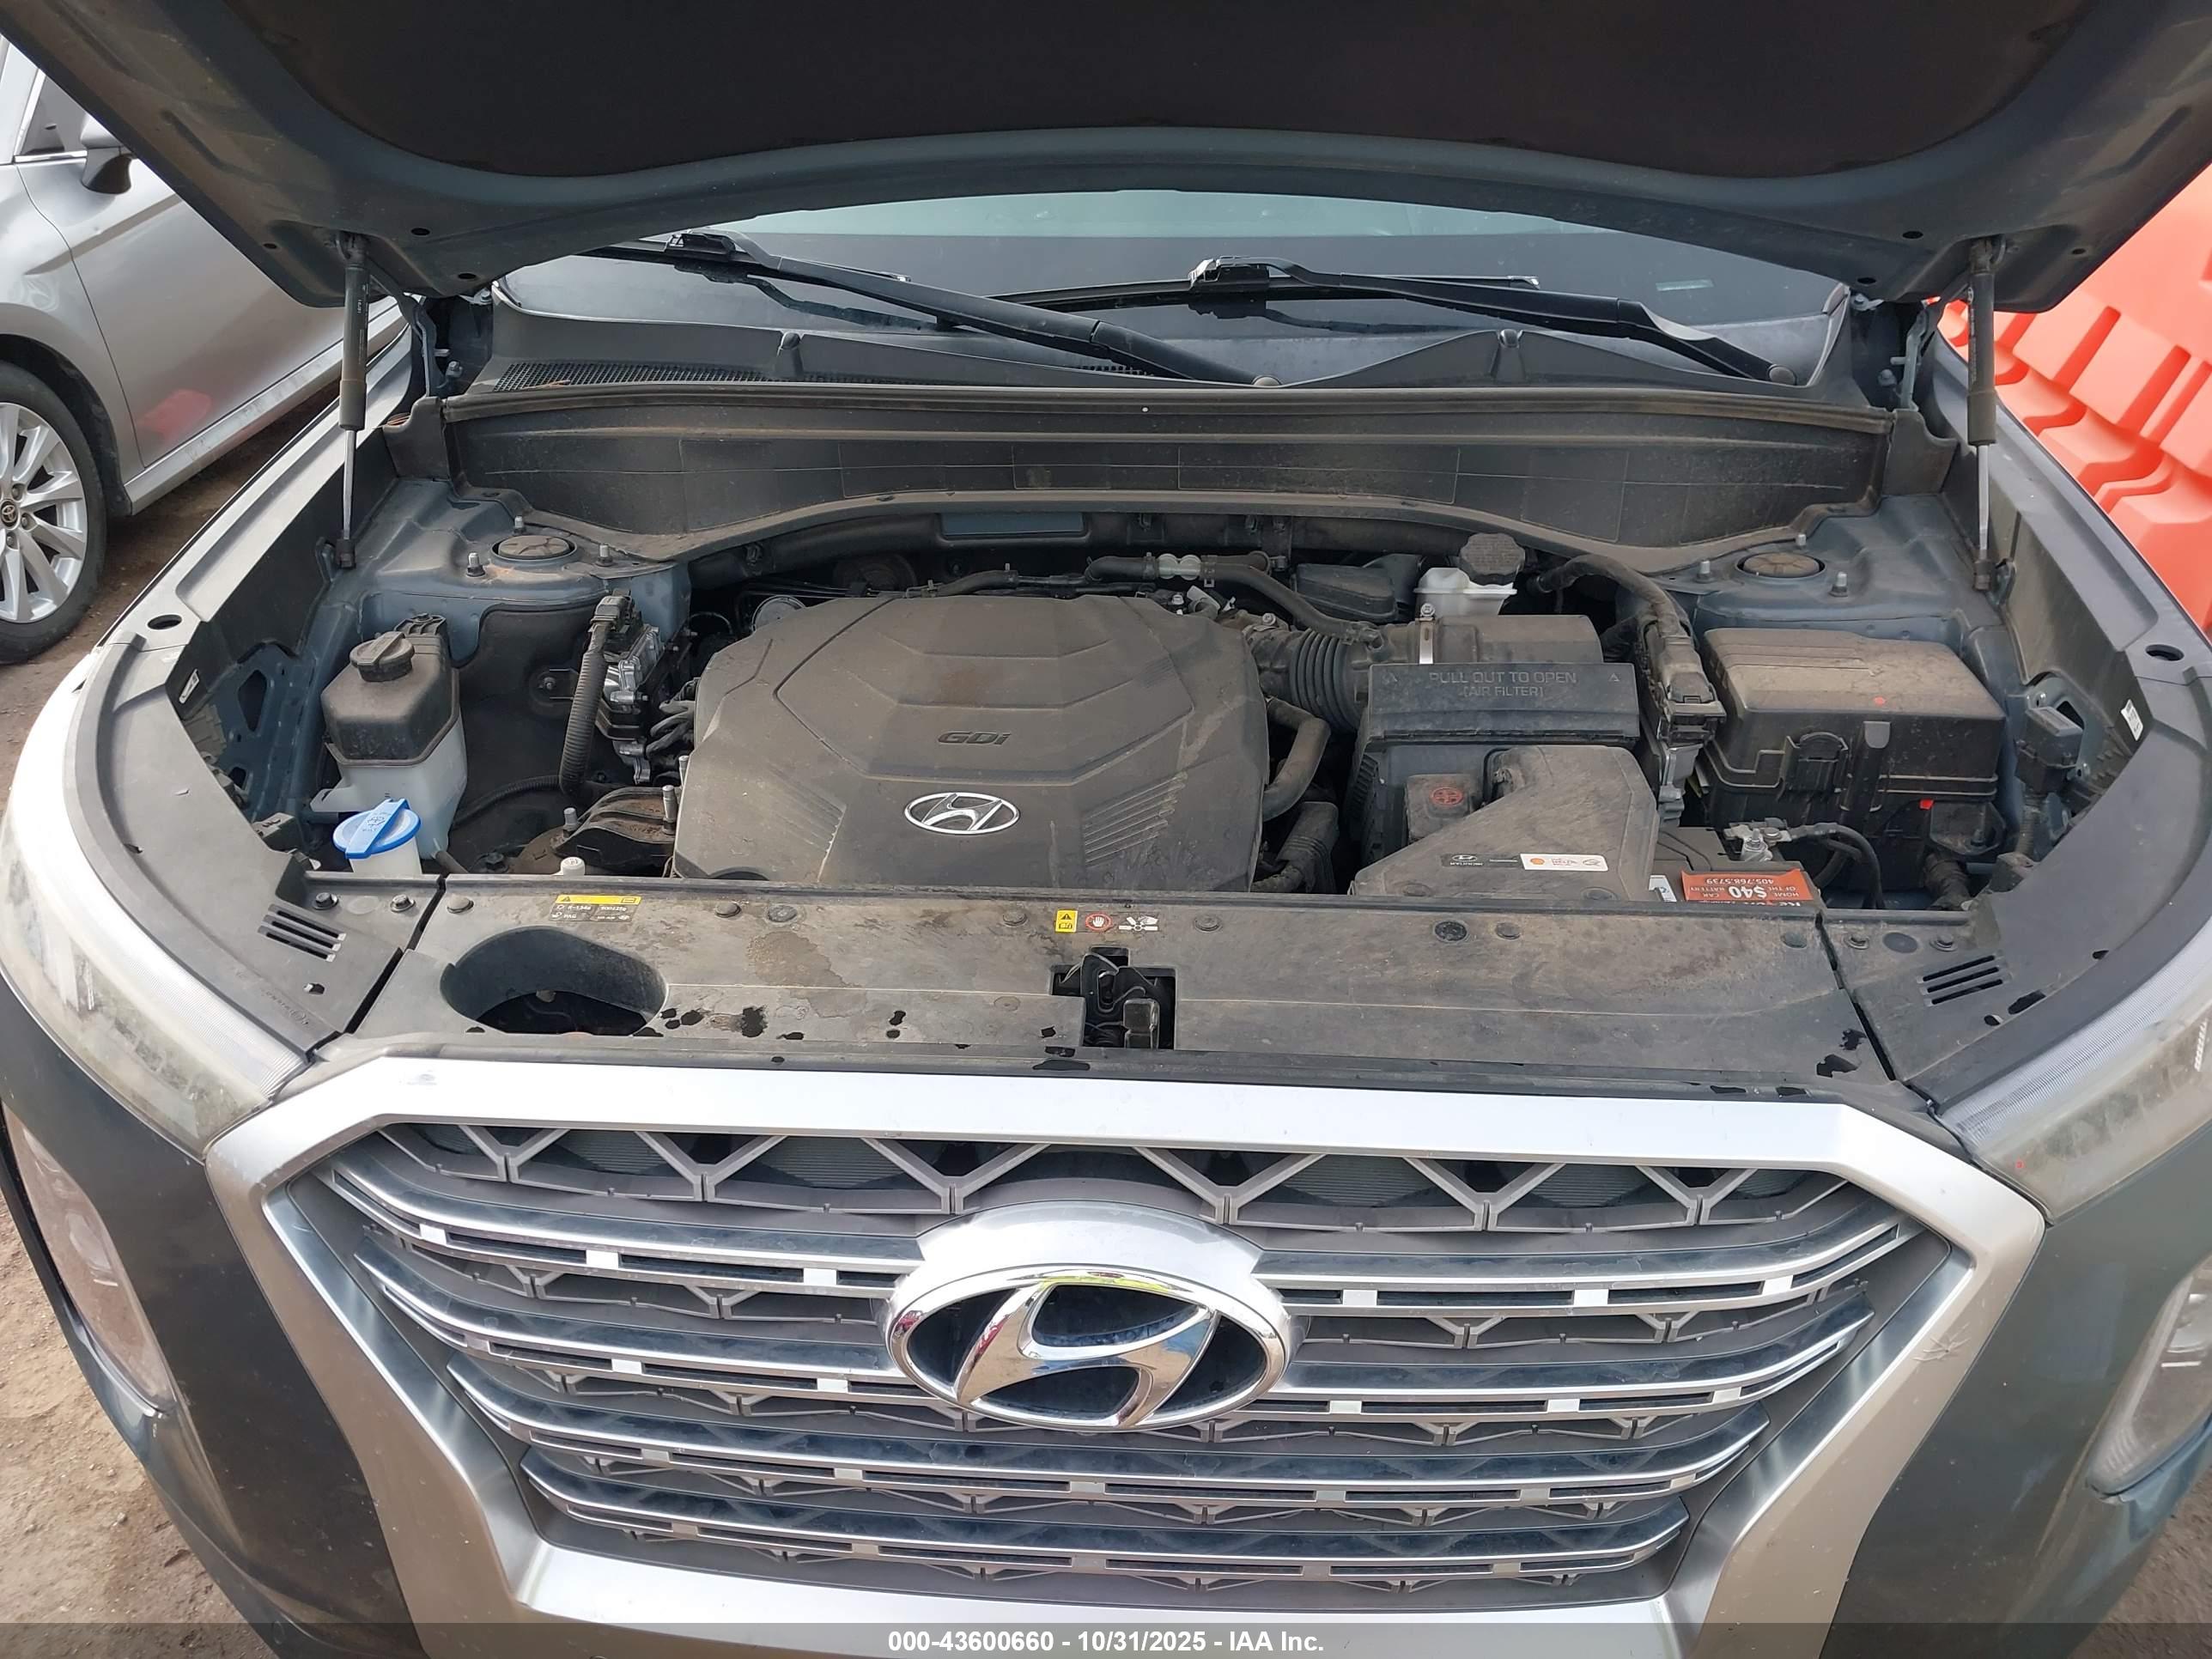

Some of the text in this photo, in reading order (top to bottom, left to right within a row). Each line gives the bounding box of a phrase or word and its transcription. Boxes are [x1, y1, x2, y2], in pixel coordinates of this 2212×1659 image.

[1429, 672, 1577, 684] PULL OUT TO OPEN
[1728, 885, 1767, 899] $40
